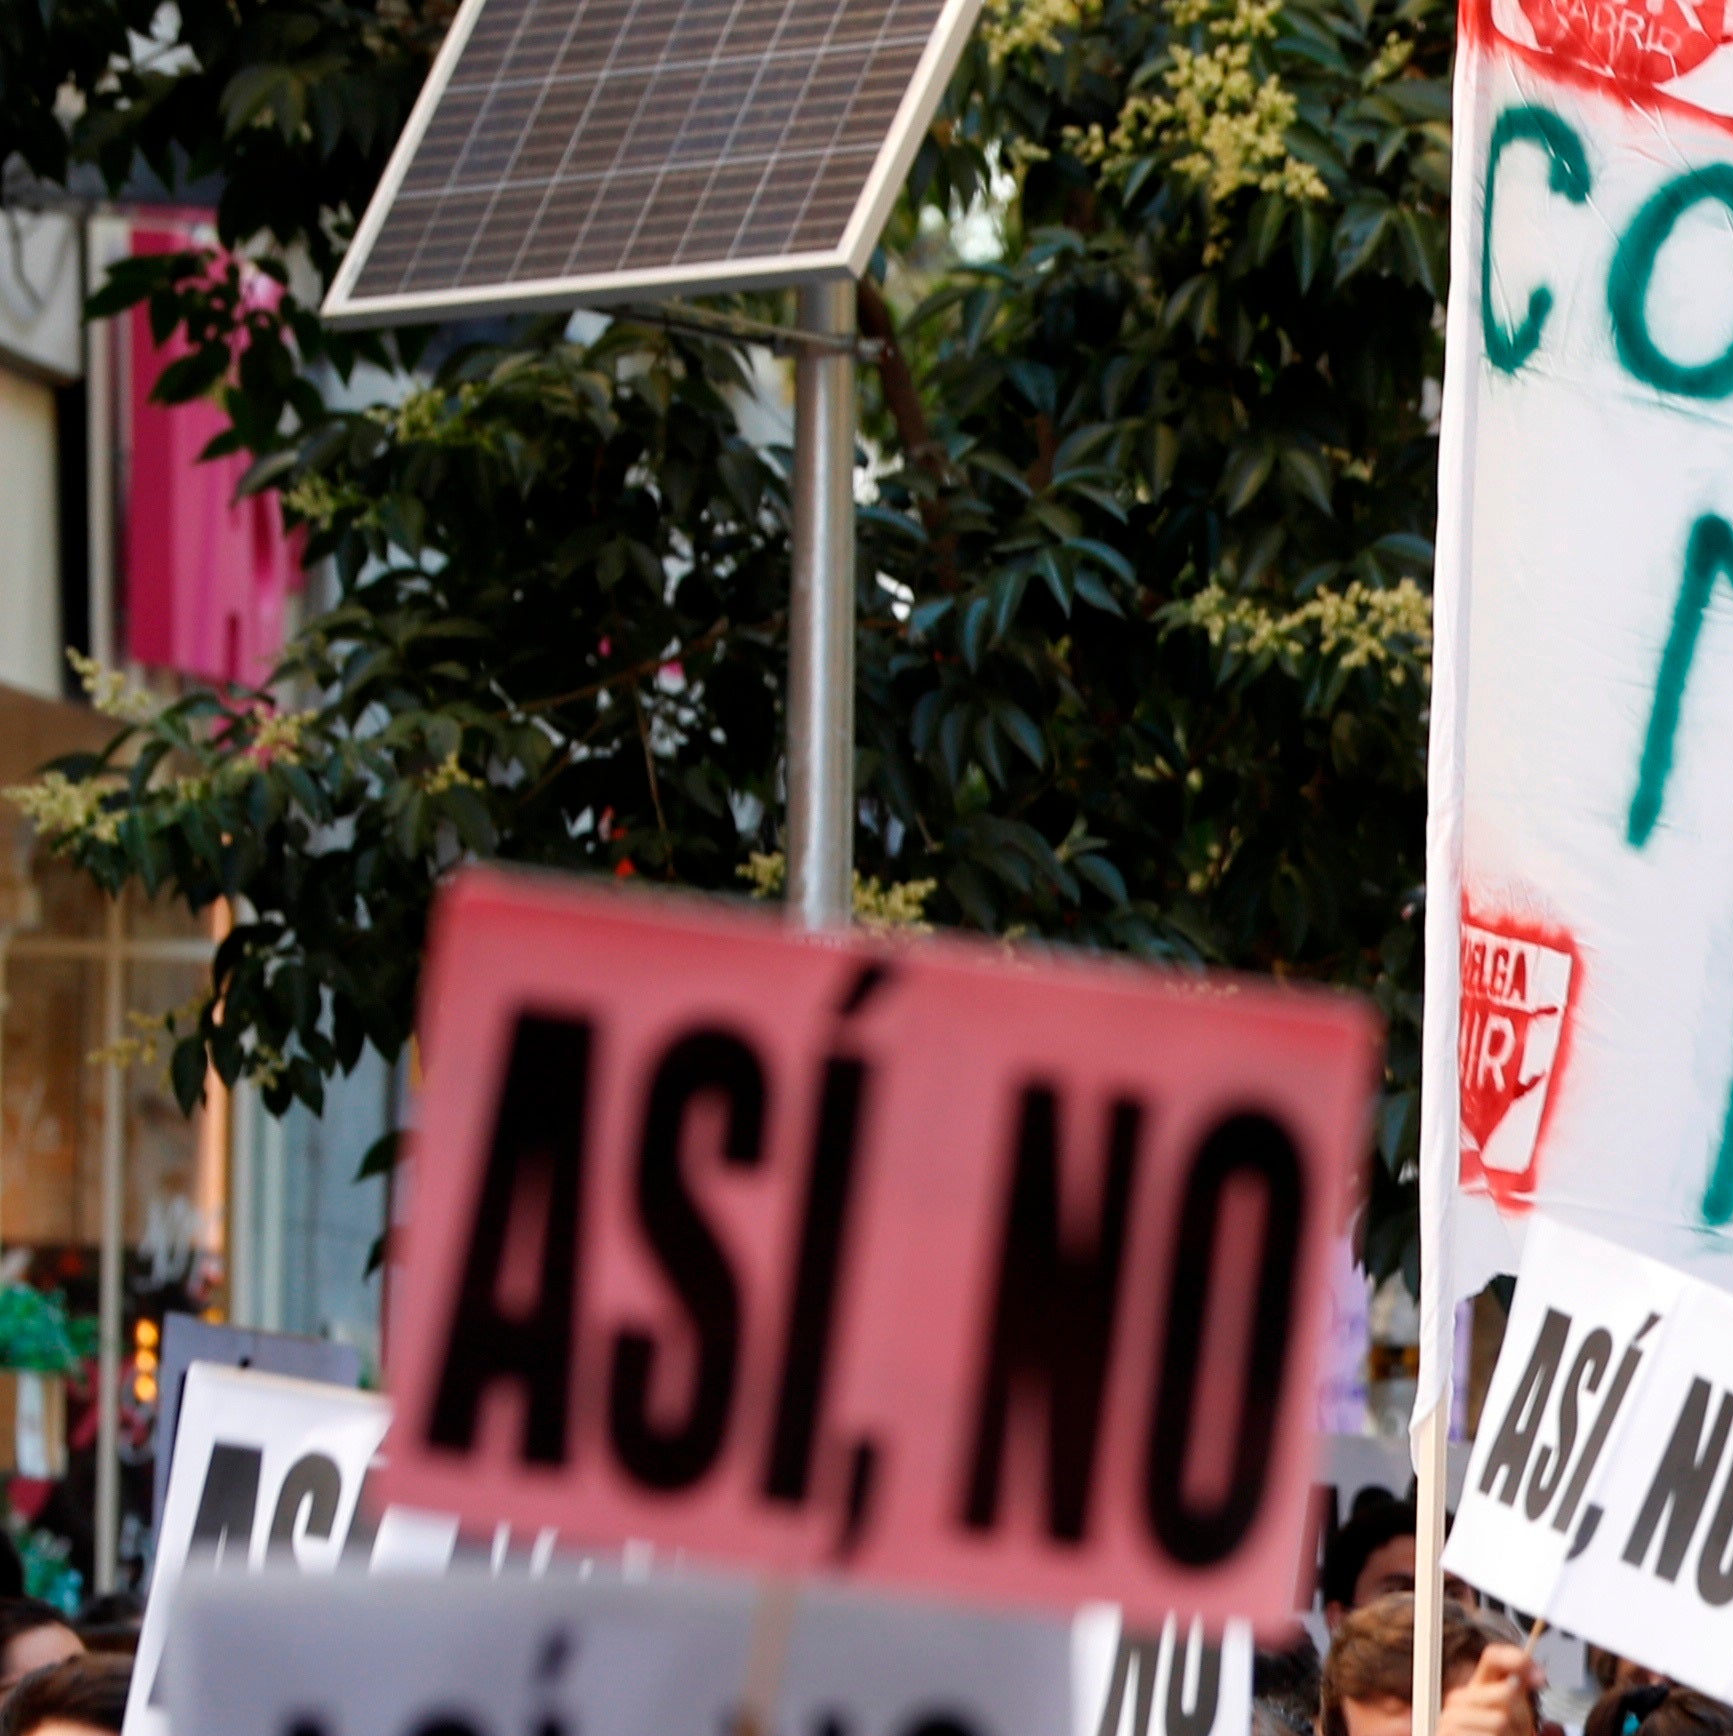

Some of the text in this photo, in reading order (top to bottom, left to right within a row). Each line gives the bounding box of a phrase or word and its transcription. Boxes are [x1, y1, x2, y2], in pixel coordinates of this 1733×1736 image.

[421, 960, 1311, 1573] ASÍ, NO
[1479, 1307, 1662, 1562] ASÍ,
